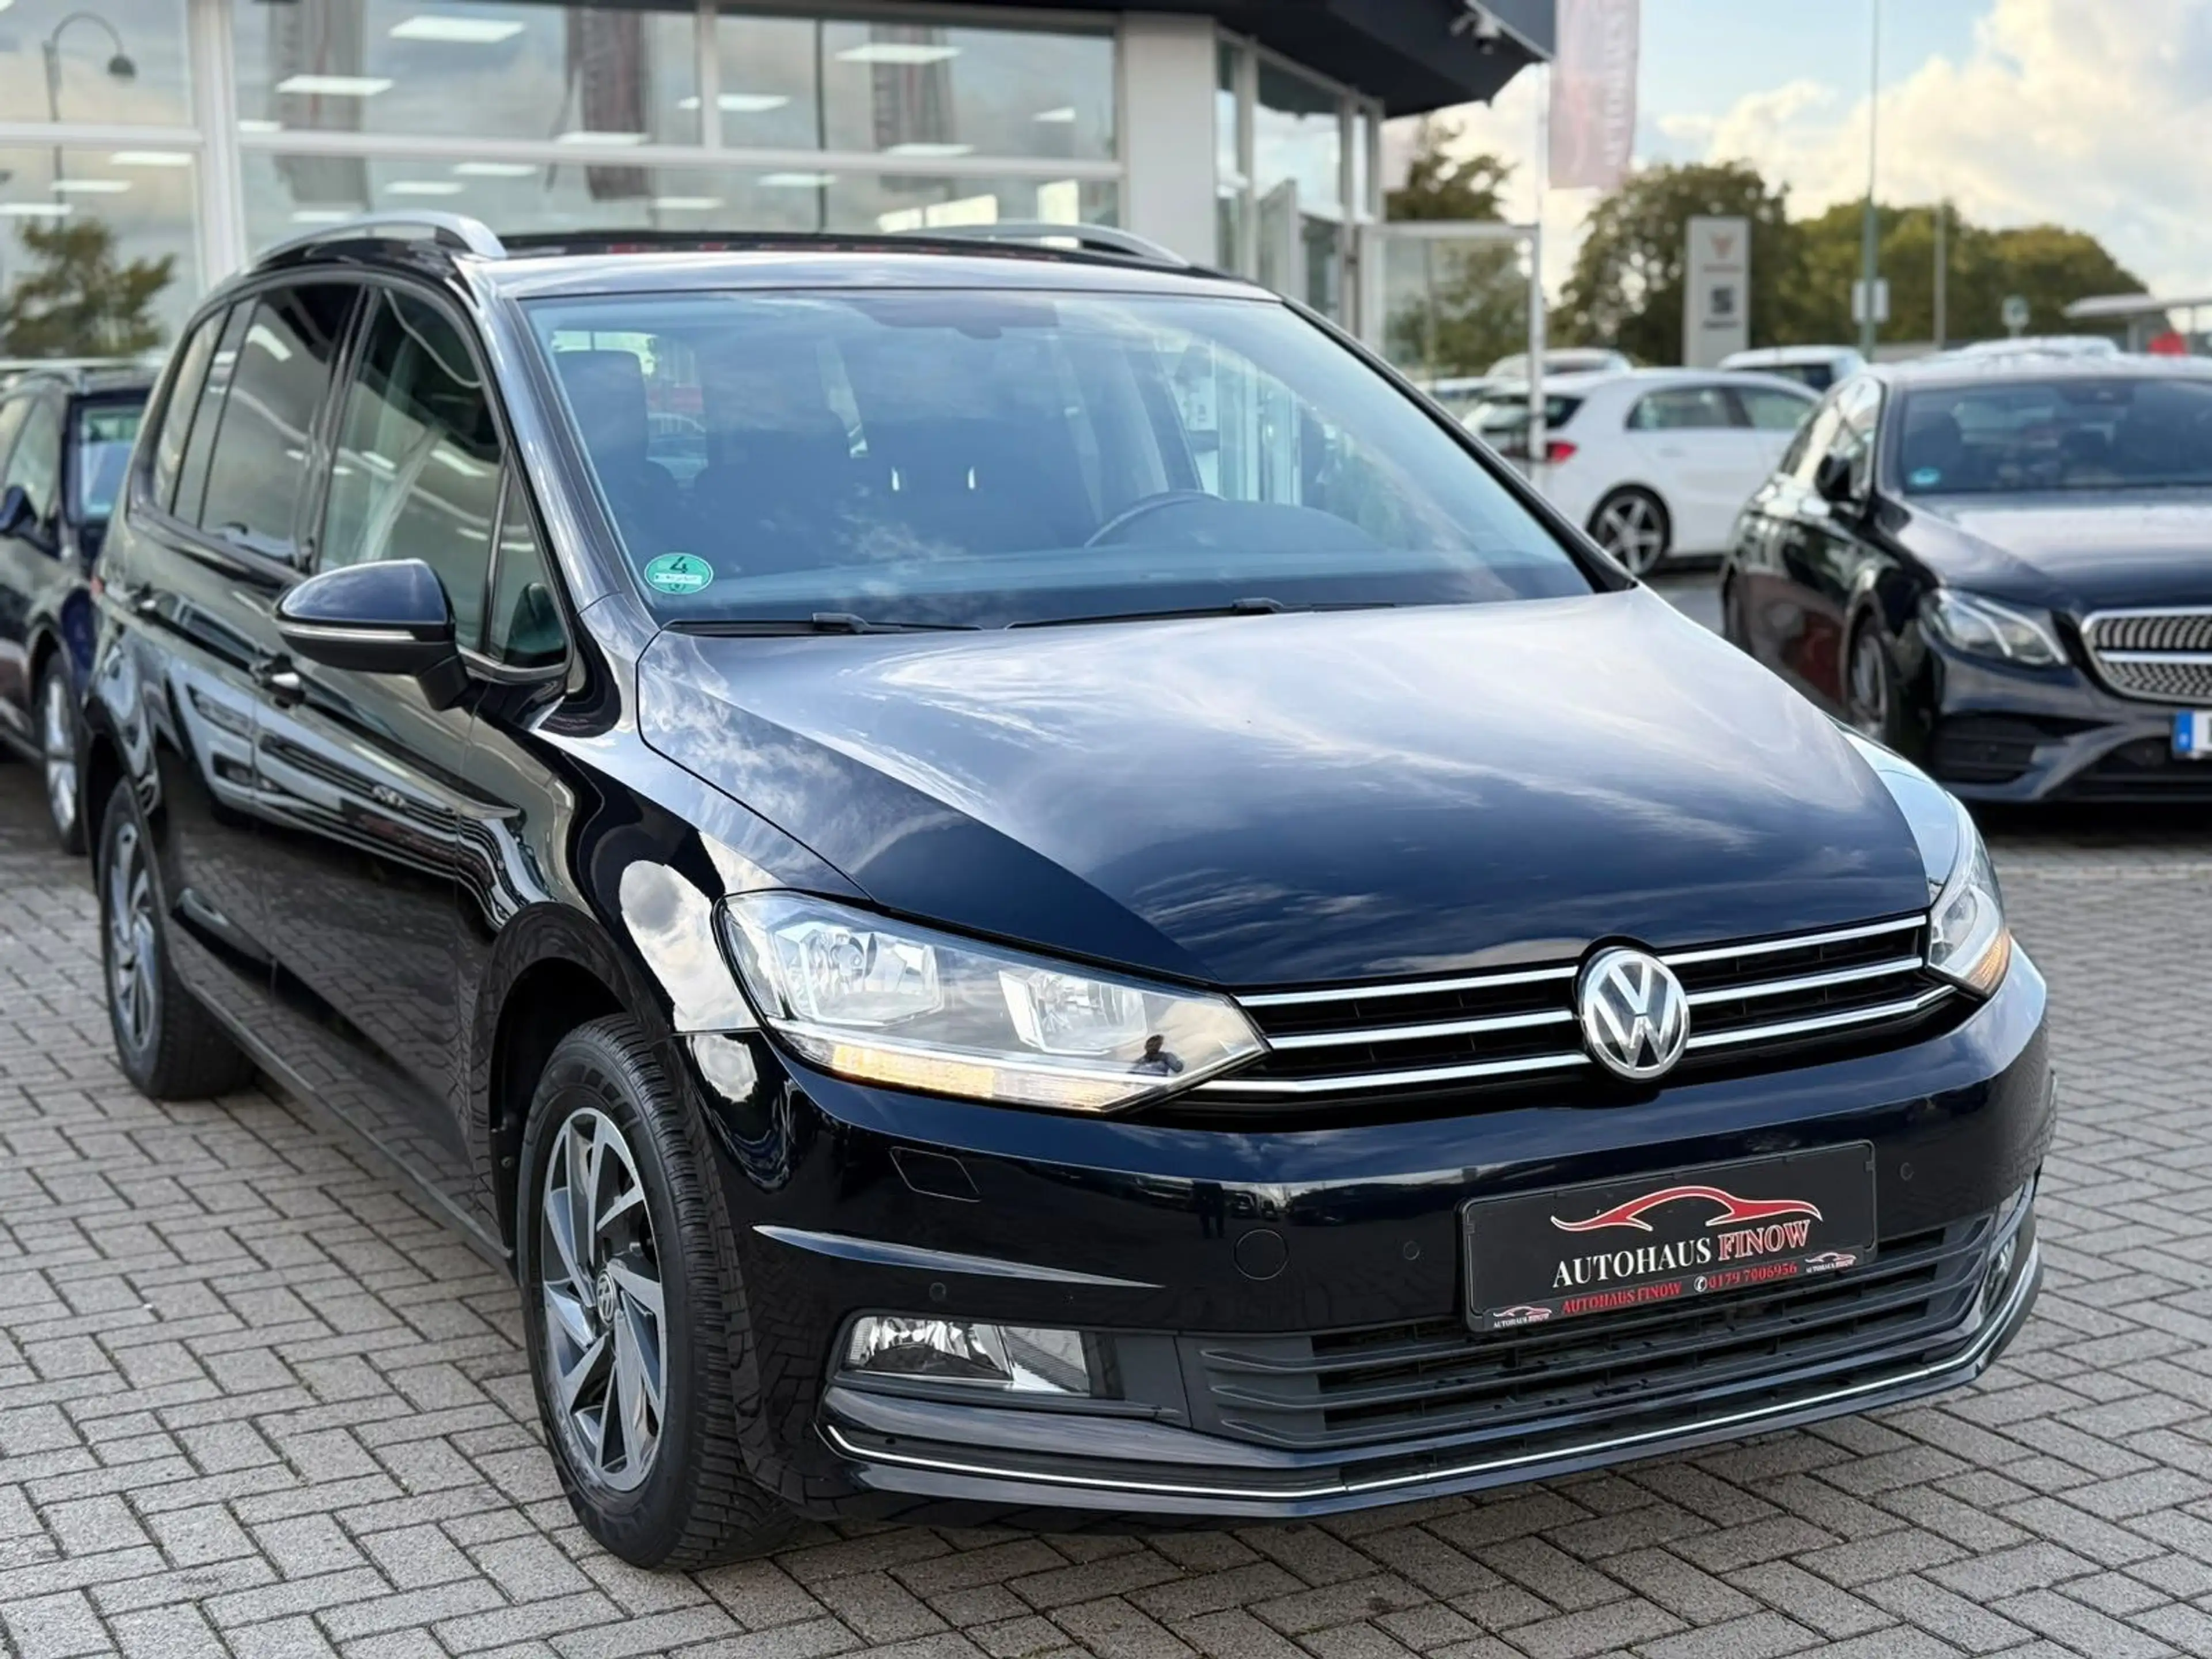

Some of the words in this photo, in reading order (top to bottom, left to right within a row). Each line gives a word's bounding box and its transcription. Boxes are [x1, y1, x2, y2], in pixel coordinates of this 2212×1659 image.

[669, 556, 688, 574] 4
[1552, 1238, 1711, 1287] AUTOHAUS
[1718, 1219, 1810, 1261] FINOW
[1563, 1289, 1635, 1314] AUTOHAUS
[1637, 1281, 1682, 1302] FINOW
